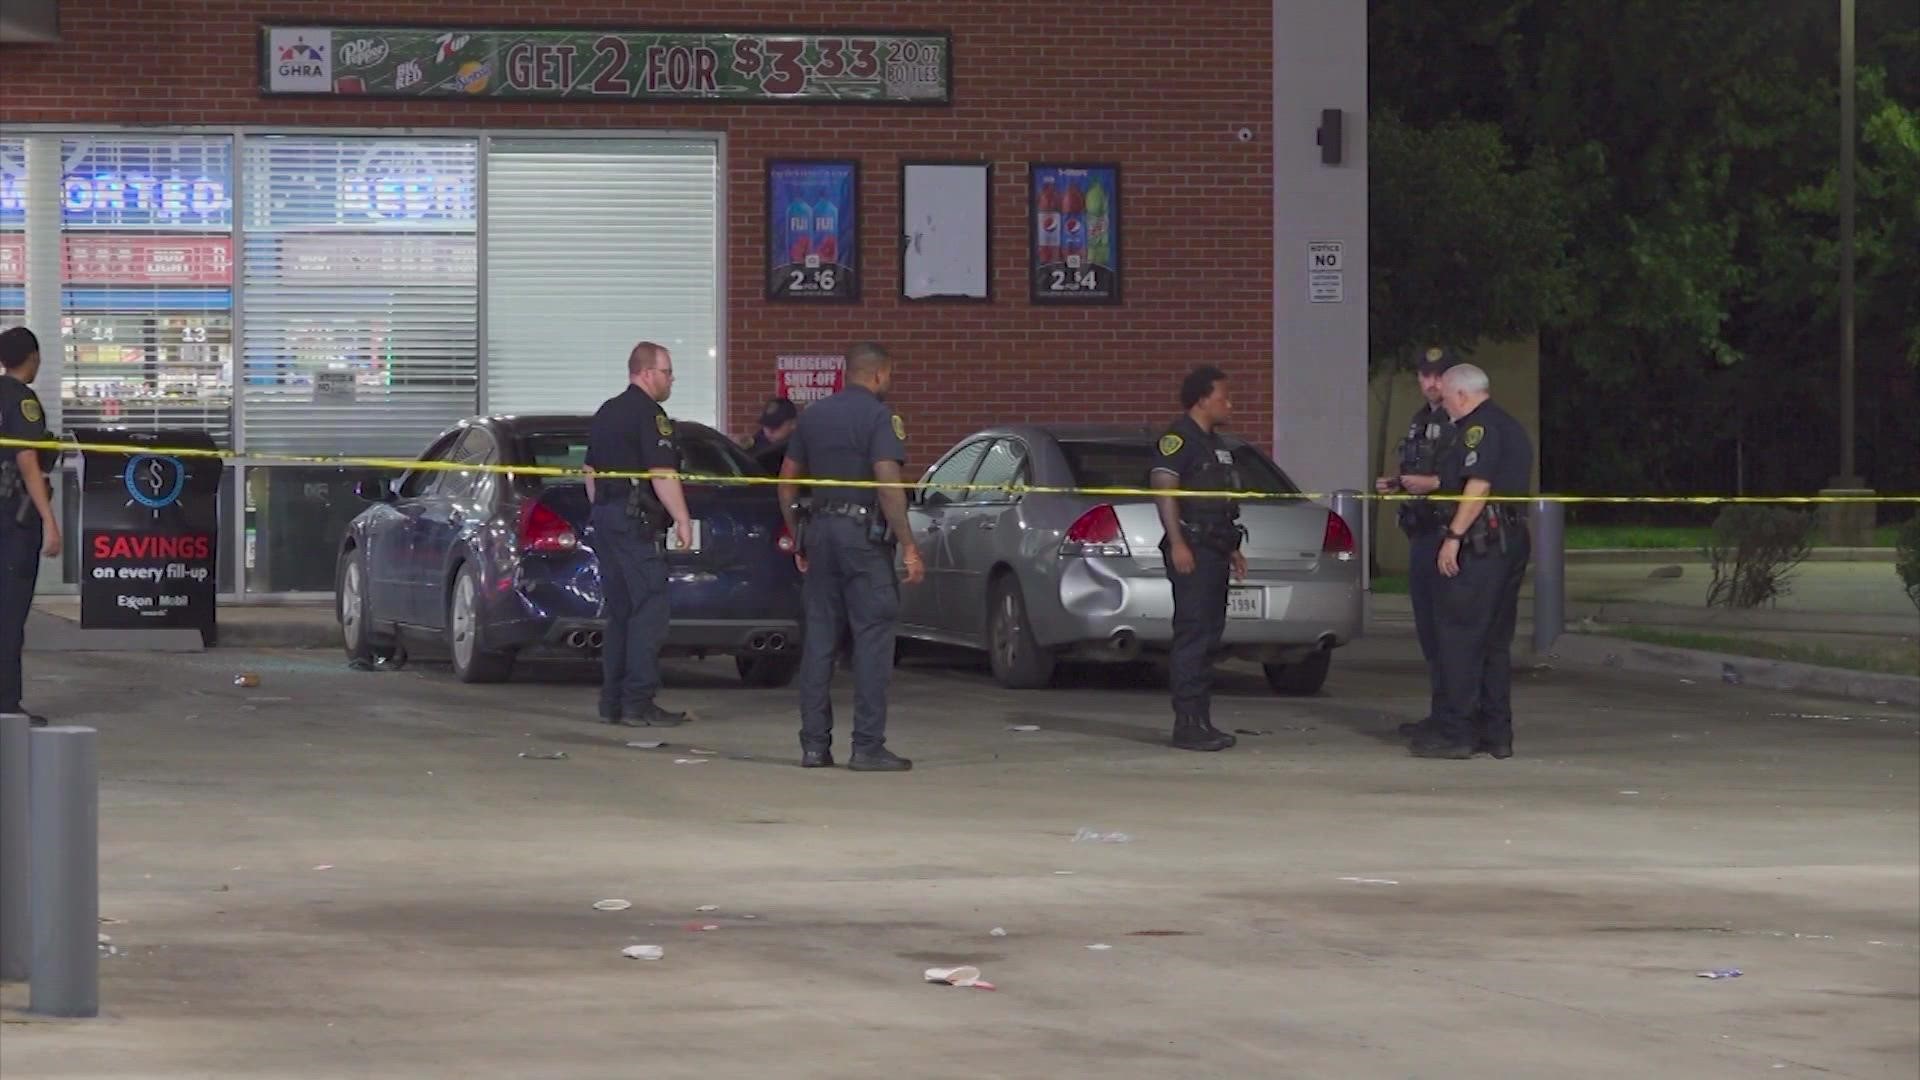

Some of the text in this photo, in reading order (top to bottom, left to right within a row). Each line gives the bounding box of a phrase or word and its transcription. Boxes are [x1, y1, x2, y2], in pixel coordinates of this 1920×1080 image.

[887, 42, 918, 62] 20
[279, 65, 322, 77] GHRA
[507, 44, 576, 90] GET
[593, 35, 629, 93] 2
[646, 46, 718, 92] FOR
[1315, 254, 1336, 266] NO
[789, 269, 805, 290] 2
[813, 269, 835, 290] $6
[1050, 271, 1066, 290] 2
[1074, 270, 1097, 290] $4
[182, 327, 206, 342] 13
[777, 357, 842, 370] EMERGENCY
[784, 371, 836, 386] SHUT-OFF
[94, 536, 209, 558] SAVINGS
[92, 563, 207, 583] on every fill-up
[117, 595, 189, 609] Exxon Mobil
